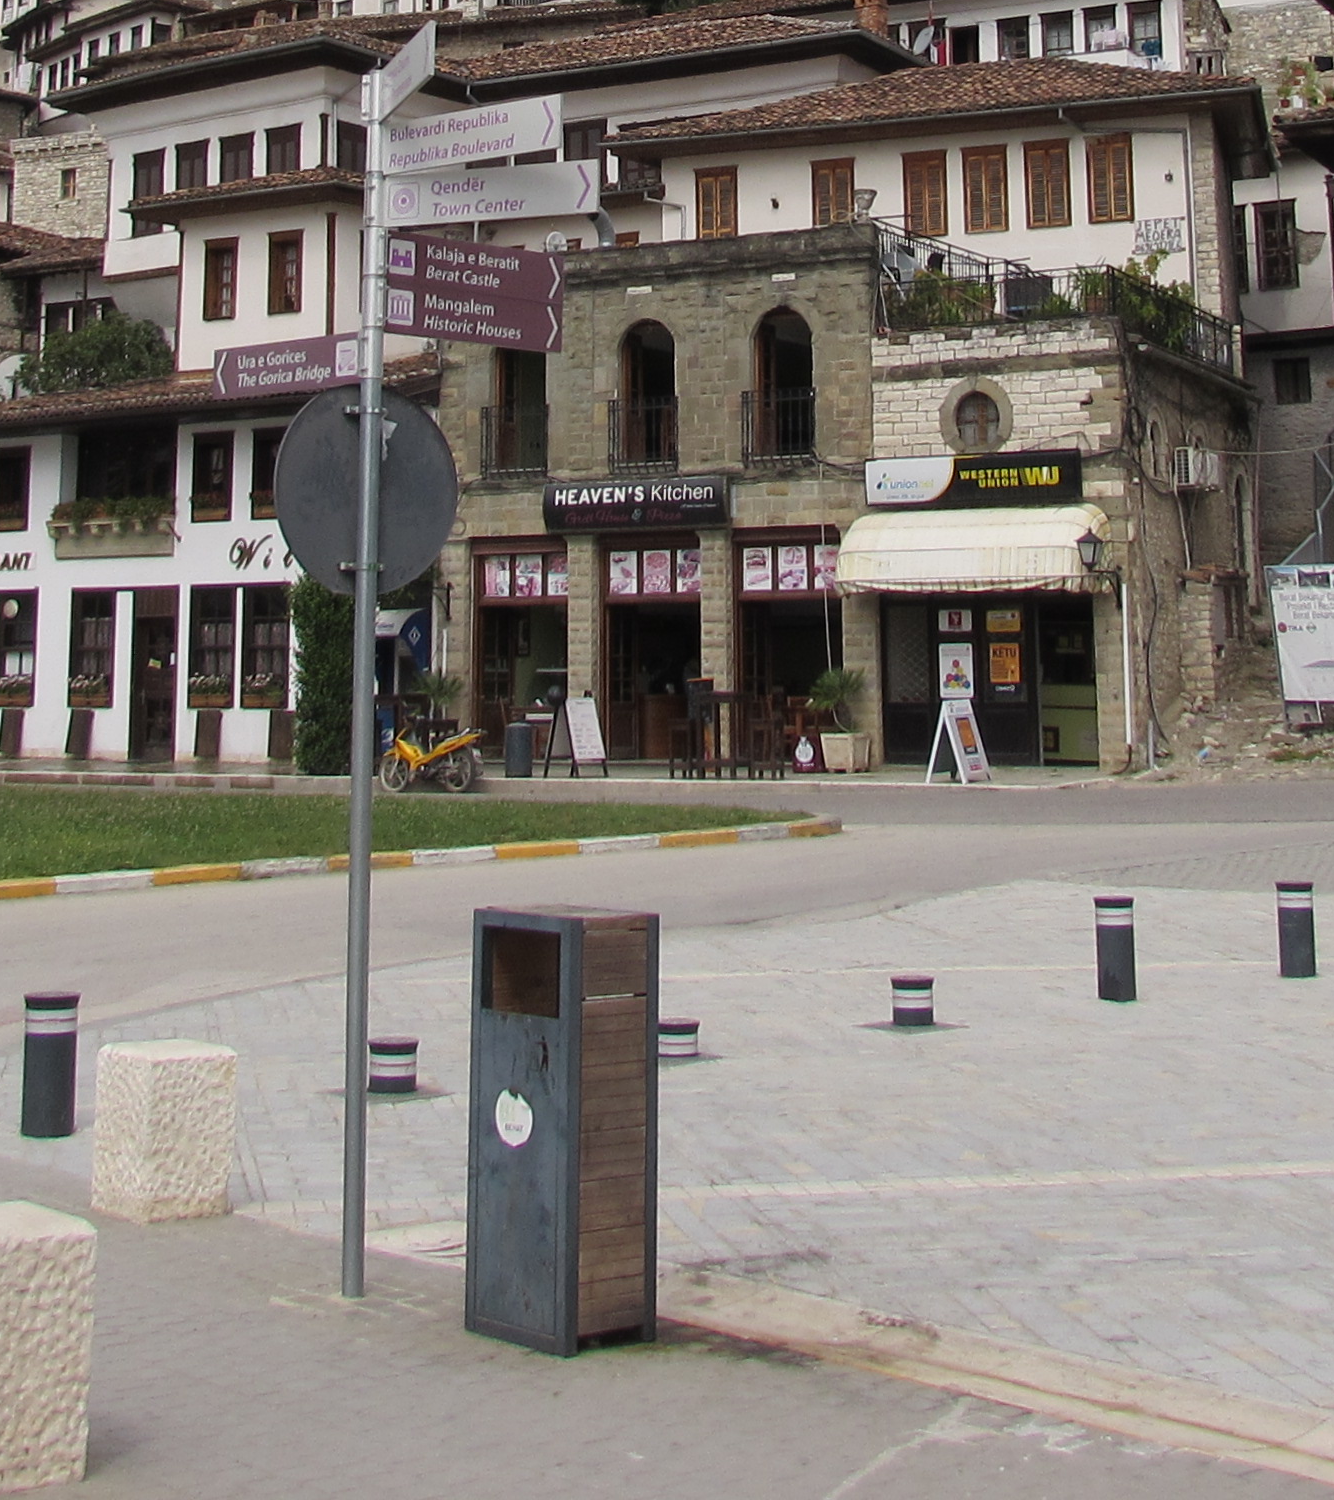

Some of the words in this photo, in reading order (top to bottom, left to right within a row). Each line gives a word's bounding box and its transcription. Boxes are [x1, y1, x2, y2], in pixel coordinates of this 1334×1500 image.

[389, 123, 446, 142] Bulevardi
[447, 111, 509, 134] Republika
[388, 147, 448, 169] Republika
[451, 133, 515, 158] Boulevard
[430, 176, 486, 197] Qendër
[431, 201, 472, 217] Town
[474, 197, 526, 214] Center
[426, 244, 465, 266] Kalaja
[467, 254, 476, 265] e
[478, 254, 520, 271] Beratit
[425, 265, 460, 283] Berat
[462, 270, 501, 289] Castle
[424, 293, 495, 317] Mangalem
[423, 314, 473, 335] Historic
[475, 321, 522, 340] Houses
[237, 355, 256, 369] Ura
[258, 356, 265, 366] e
[266, 350, 307, 366] Gorices
[237, 373, 256, 388] The
[258, 369, 293, 385] Gorica
[294, 364, 332, 384] Bridge
[959, 468, 1018, 480] WESTERN
[978, 478, 1019, 489] UNION
[1023, 466, 1060, 486] WU
[554, 485, 645, 506] HEAVEN'S
[650, 484, 714, 501] Kitchen
[631, 508, 642, 522] &
